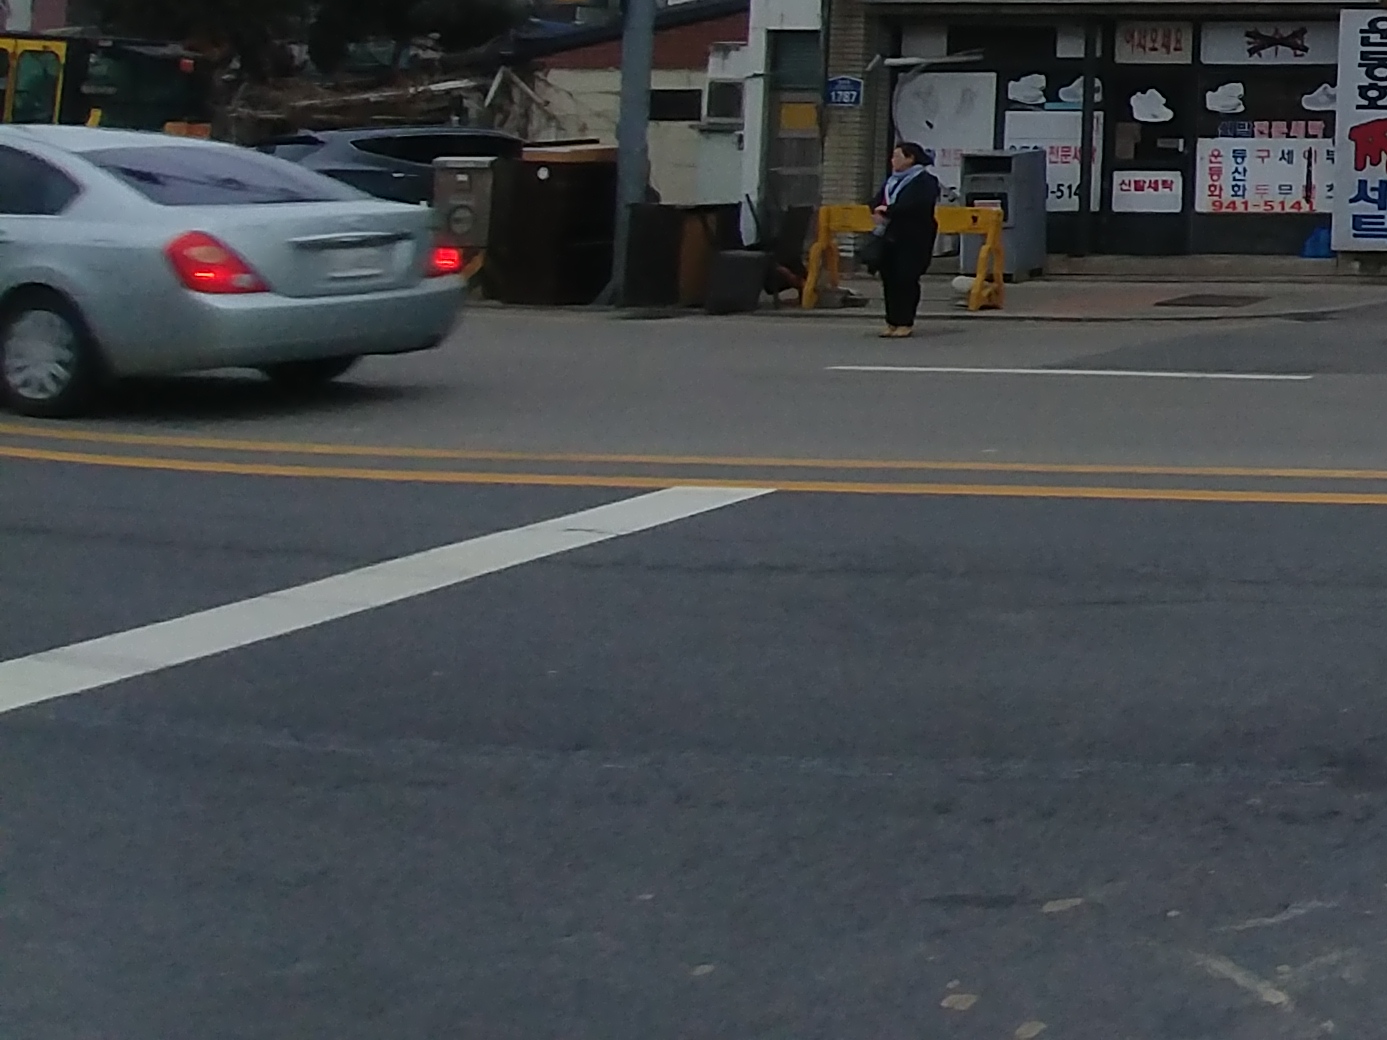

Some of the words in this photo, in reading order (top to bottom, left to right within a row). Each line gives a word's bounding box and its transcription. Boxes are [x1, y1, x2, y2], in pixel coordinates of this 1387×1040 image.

[830, 91, 858, 103] 1787
[1119, 178, 1175, 192] 신발세탁
[1211, 200, 1317, 212] 941-5141
